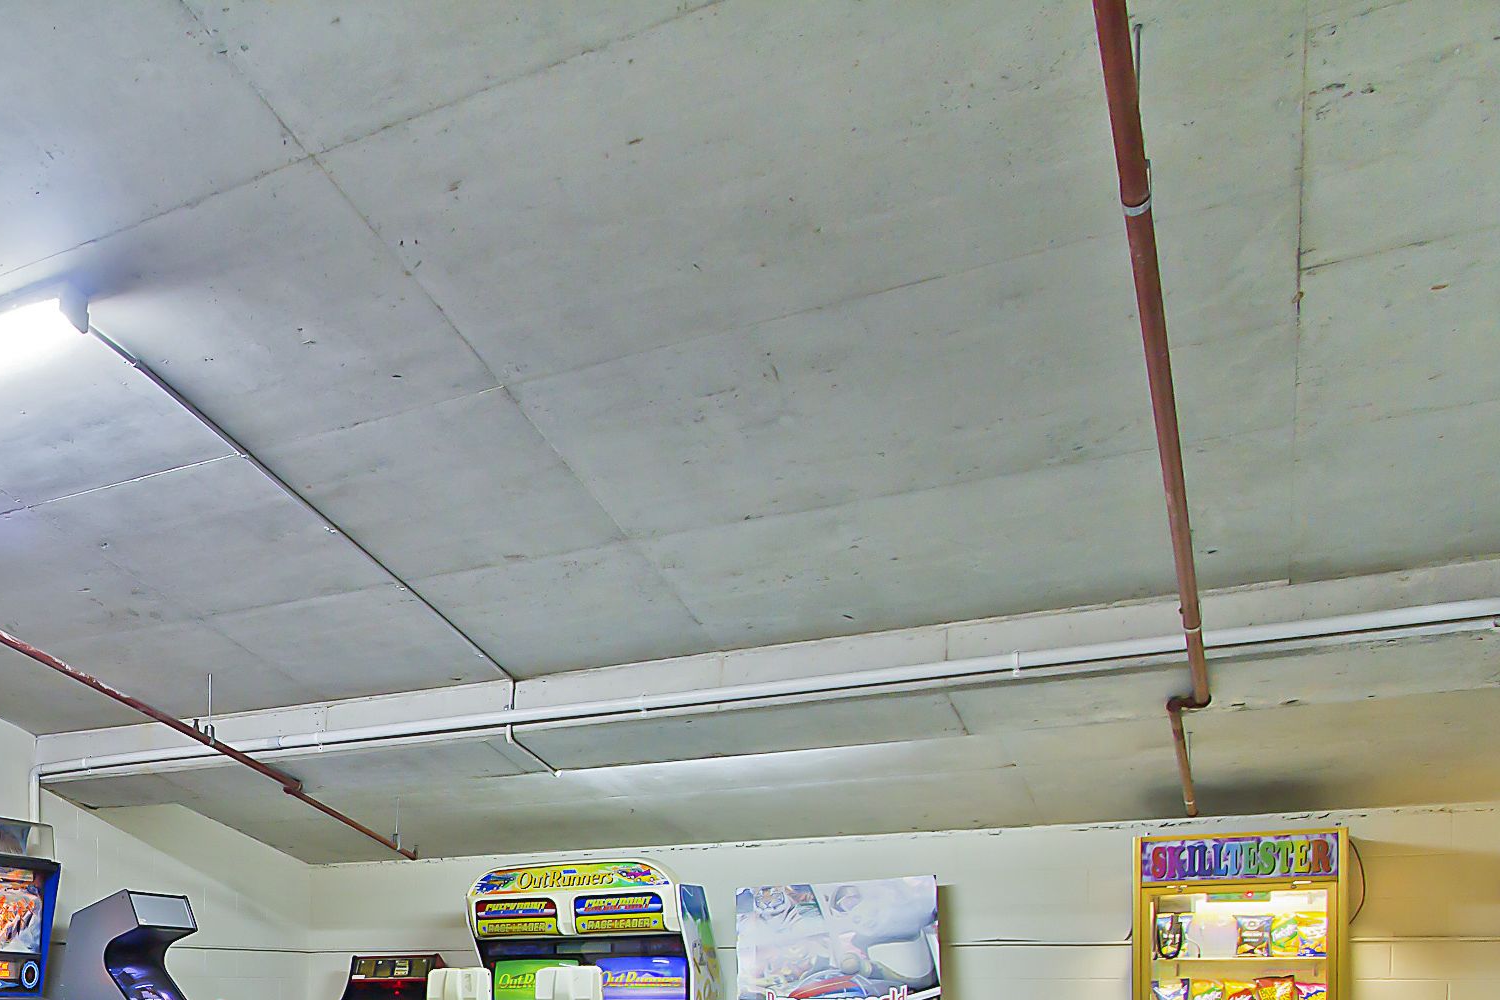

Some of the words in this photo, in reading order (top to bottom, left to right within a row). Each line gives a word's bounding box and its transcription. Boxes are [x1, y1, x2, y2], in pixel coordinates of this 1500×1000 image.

[1151, 838, 1332, 879] SKILLTESTER
[516, 868, 614, 890] OutRunners
[488, 923, 512, 933] RACE
[513, 922, 546, 932] LEADER
[587, 919, 612, 930] RACE
[614, 918, 651, 929] LEADER
